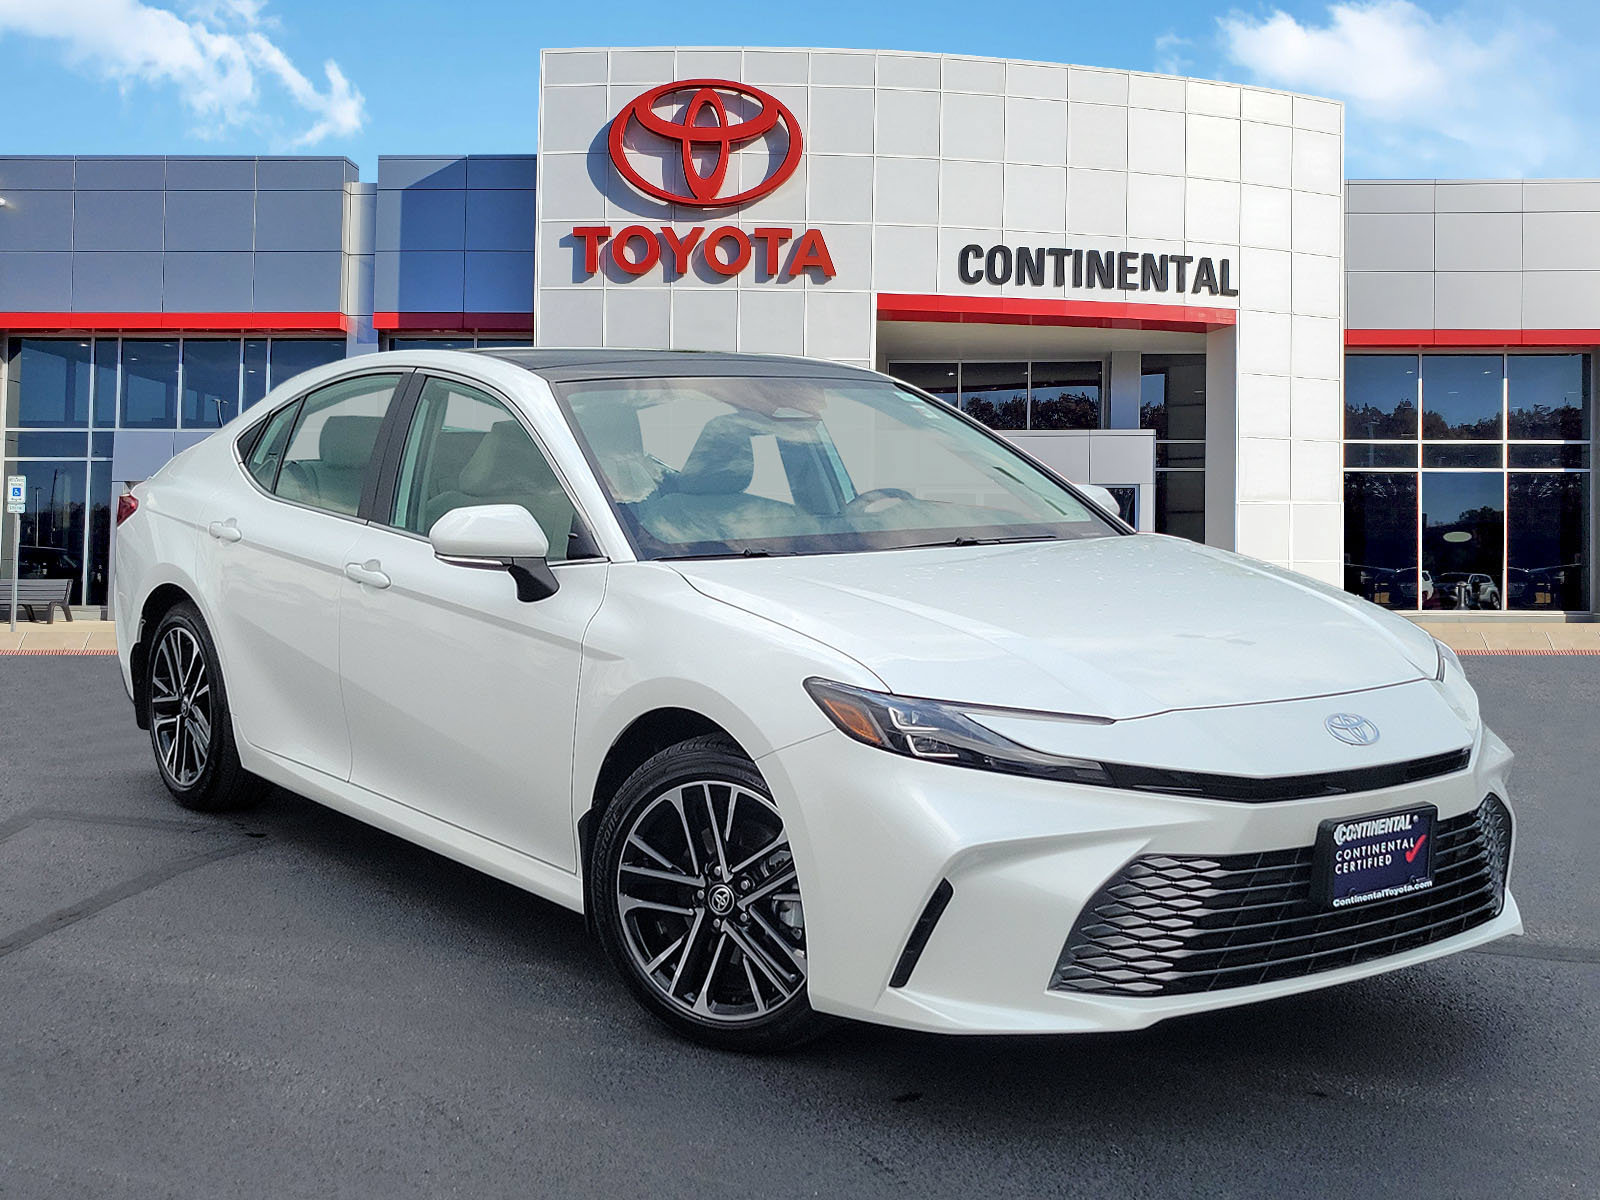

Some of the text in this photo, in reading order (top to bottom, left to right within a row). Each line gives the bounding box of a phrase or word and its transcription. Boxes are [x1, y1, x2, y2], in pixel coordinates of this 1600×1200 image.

[572, 225, 836, 277] TOYOTA
[958, 244, 1238, 296] CONTINENTAL
[1334, 814, 1412, 845] CONTINENTAL
[1335, 838, 1415, 861] CONTINENTAL
[1335, 854, 1392, 875] CERTIFIED
[1333, 880, 1433, 907] ContinentalToyota.com
